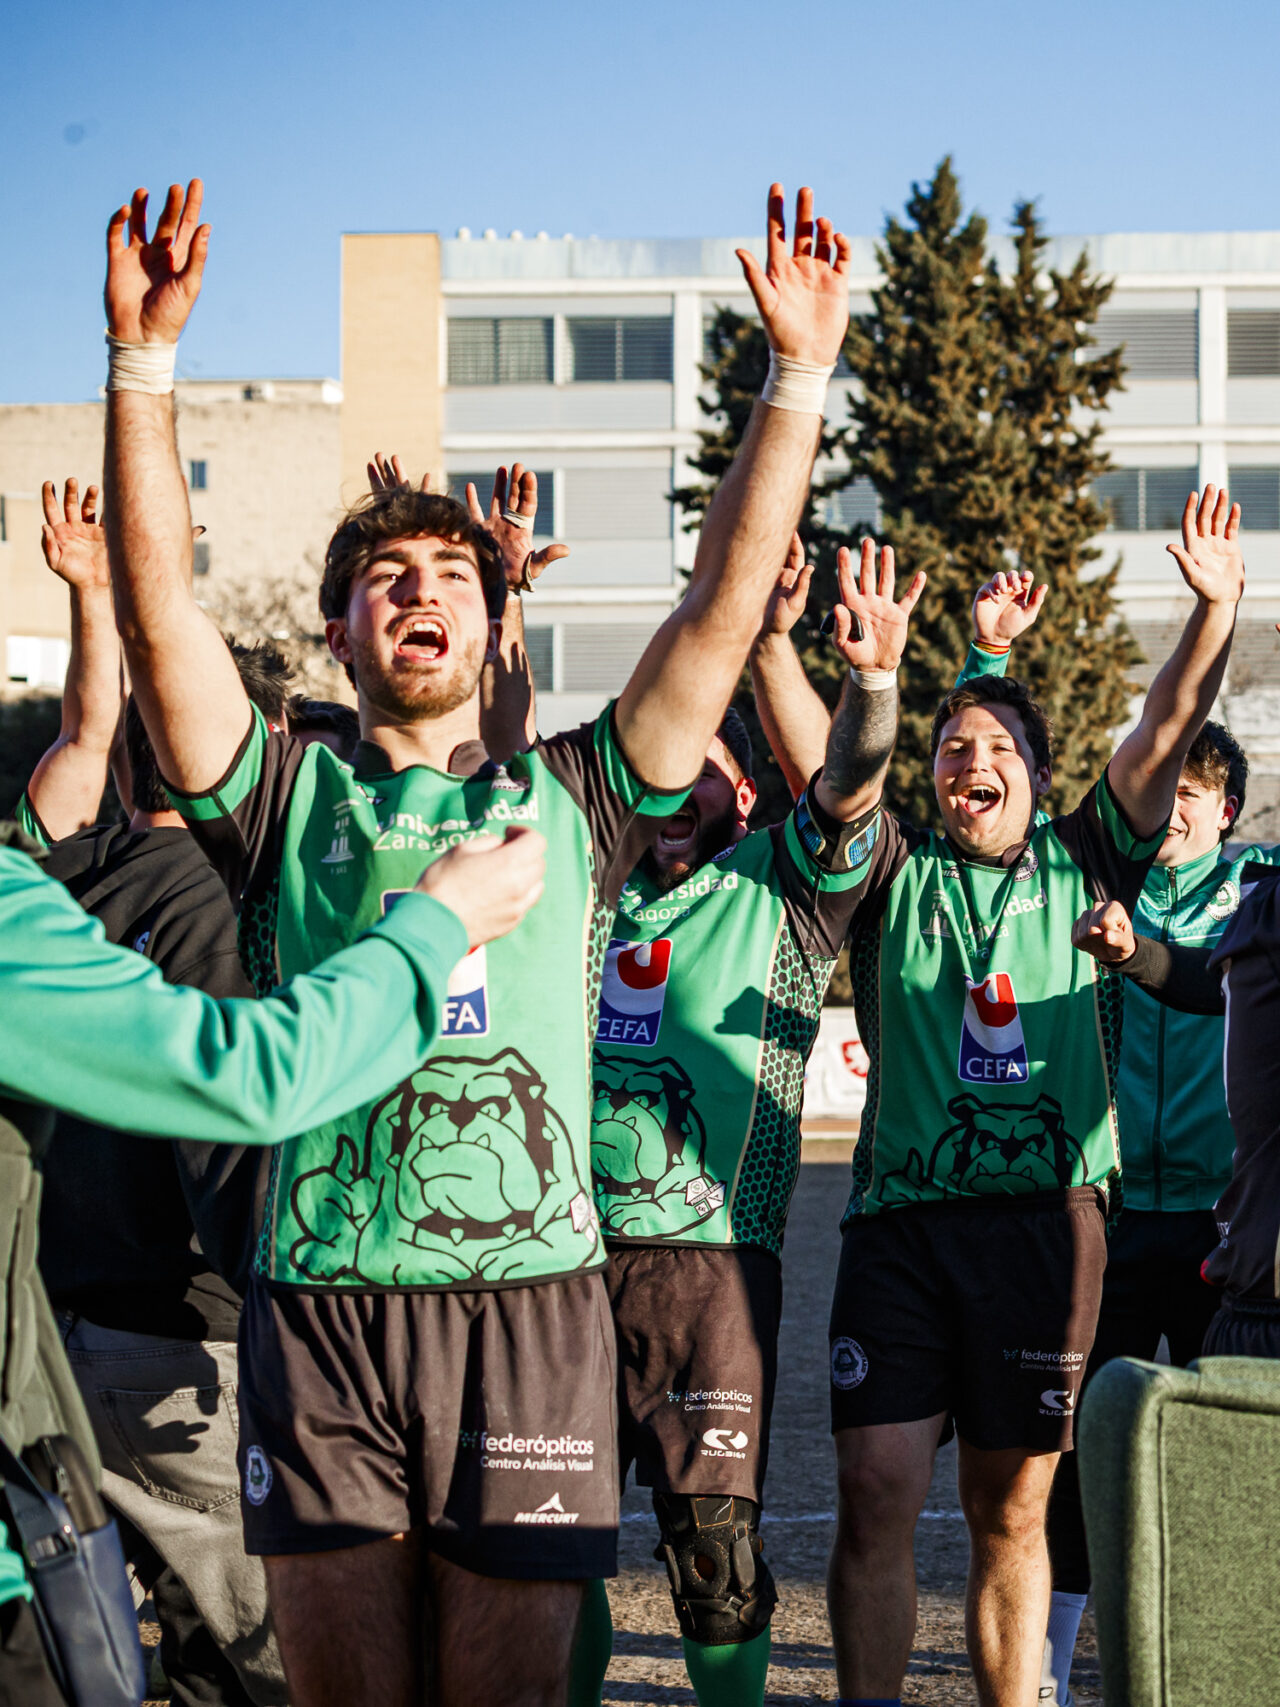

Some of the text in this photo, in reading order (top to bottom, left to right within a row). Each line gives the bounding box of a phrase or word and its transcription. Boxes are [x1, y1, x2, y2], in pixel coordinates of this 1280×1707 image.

[596, 1017, 651, 1042] CEFA
[966, 1057, 1023, 1079] CEFA
[480, 1432, 594, 1458] federópticos
[480, 1456, 594, 1472] Centro Análisis Visual
[513, 1512, 580, 1524] MERCURY
